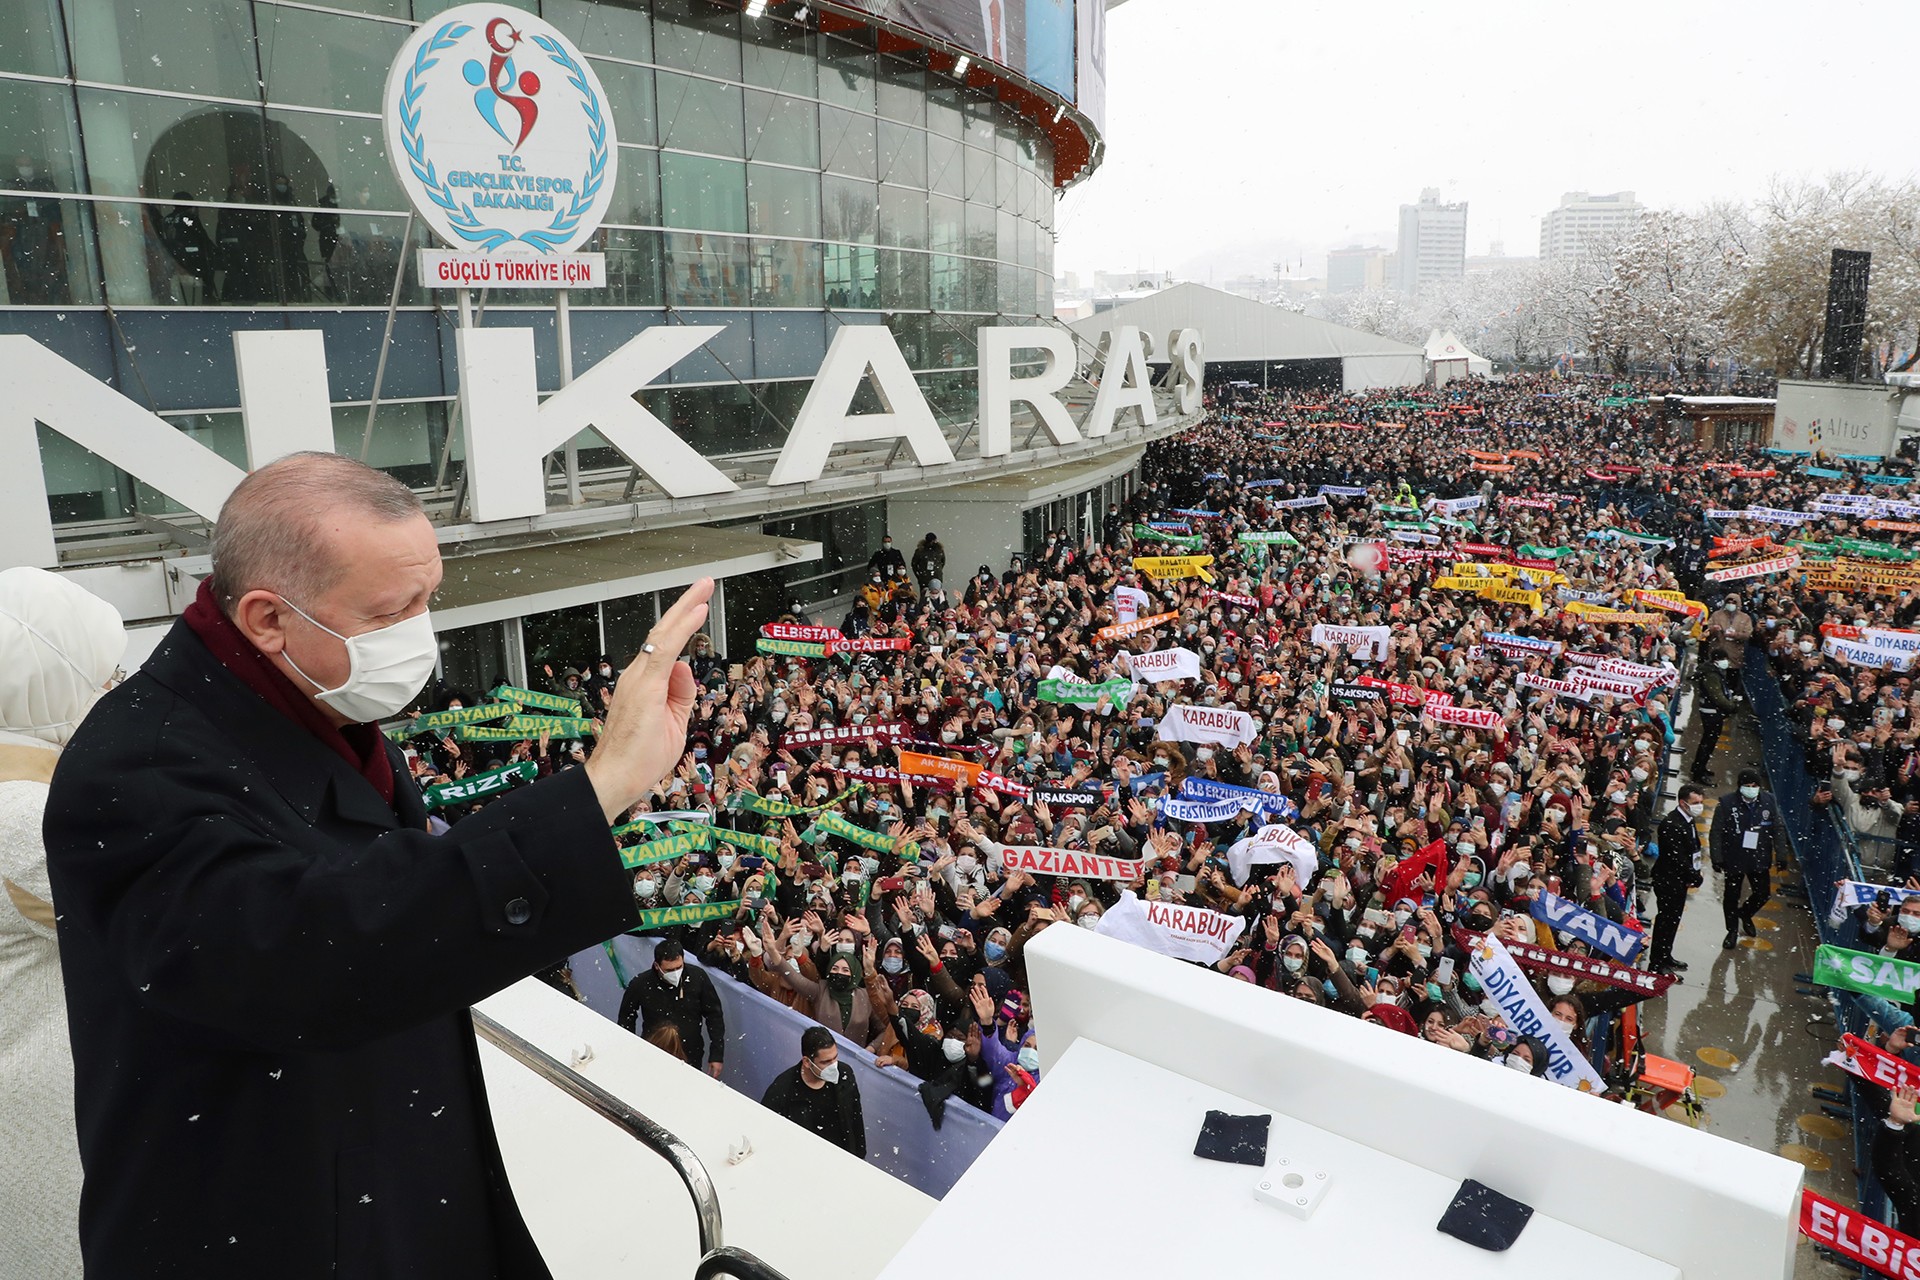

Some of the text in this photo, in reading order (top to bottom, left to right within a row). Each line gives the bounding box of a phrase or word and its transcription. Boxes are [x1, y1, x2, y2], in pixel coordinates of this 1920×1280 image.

[498, 154, 526, 172] T.C.
[516, 174, 535, 192] VE
[536, 176, 574, 194] SPOR
[473, 191, 555, 211] BAKANLIĞI
[438, 258, 591, 286] GÜÇLÜ TÜRKİYE İÇİN
[1826, 417, 1869, 440] Altus
[1242, 531, 1296, 542] SAKARYA
[1159, 558, 1191, 566] MALATYA
[1398, 549, 1452, 558] SAMSUN
[1152, 567, 1185, 577] MALATYA
[1458, 578, 1493, 588] MALATYA
[1496, 589, 1530, 602] MALATYA
[1324, 627, 1370, 647] KARABÜK
[1486, 633, 1551, 651] TRABZON
[1182, 709, 1242, 732] KARABÜK
[920, 758, 934, 767] AK
[1147, 901, 1234, 944] KARABÜK
[1545, 895, 1638, 958] VAN
[1468, 933, 1658, 991] ZNGULDAK
[1484, 966, 1574, 1080] DİYARBAKIR
